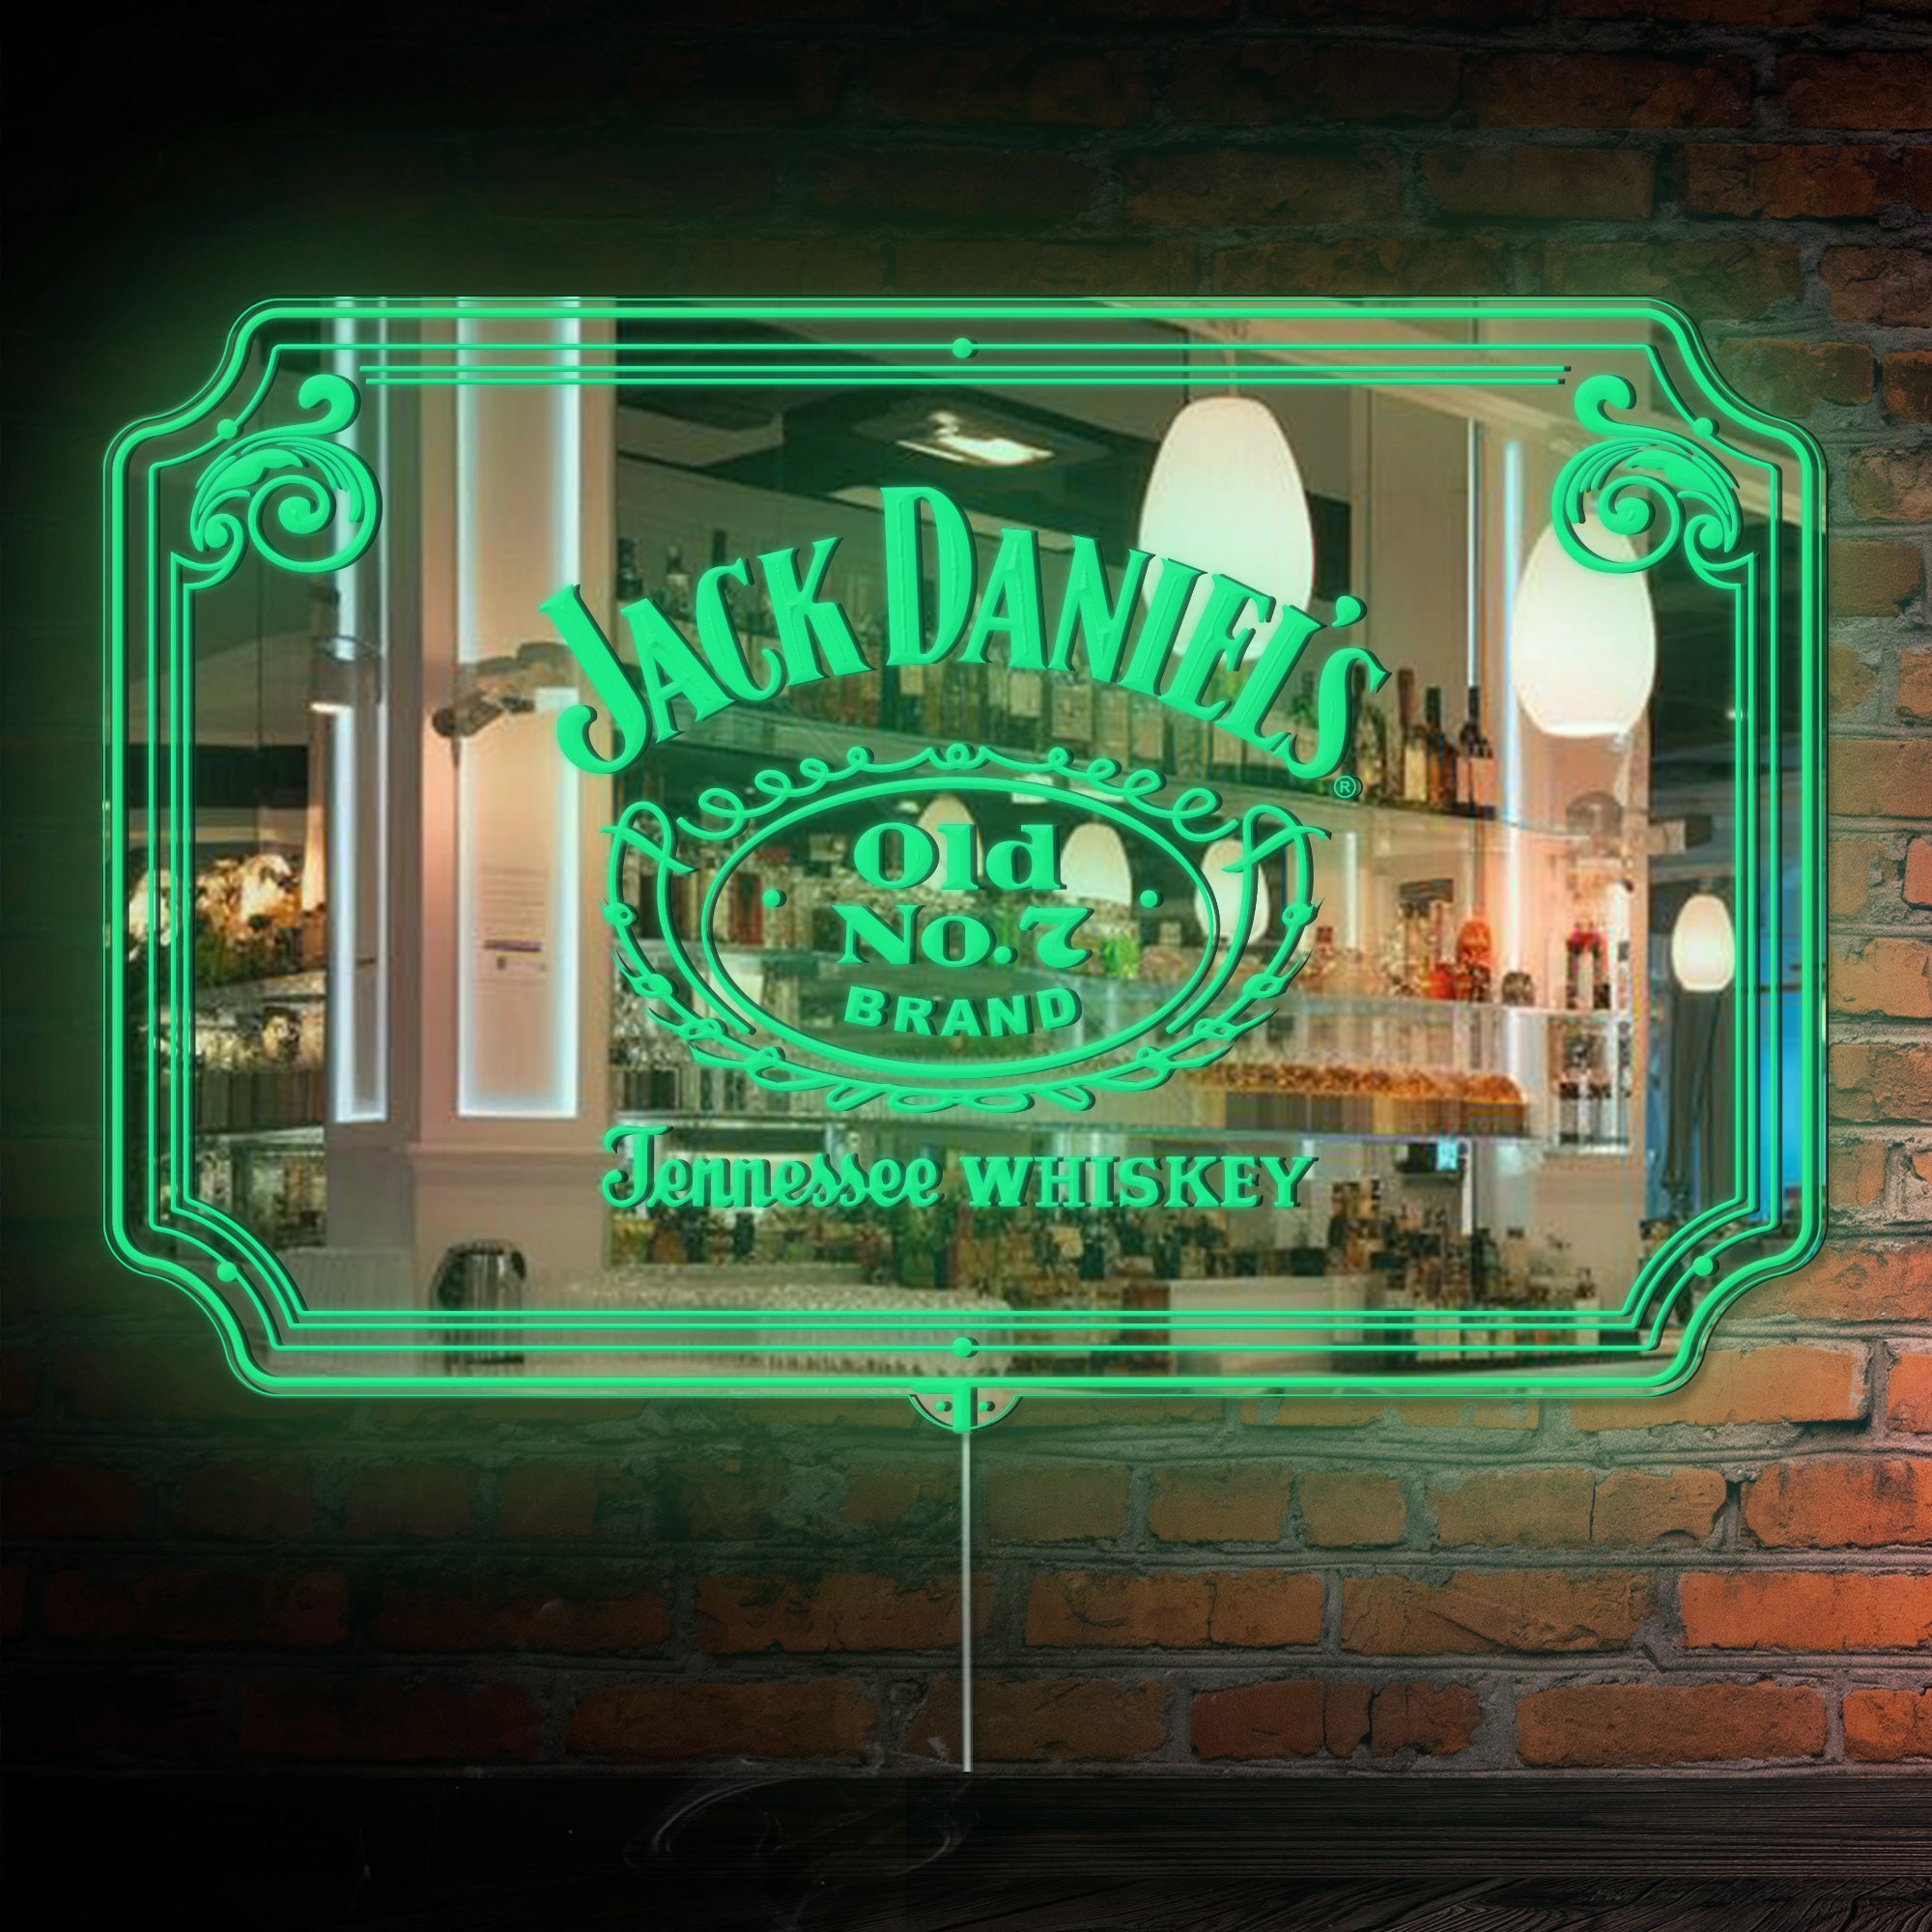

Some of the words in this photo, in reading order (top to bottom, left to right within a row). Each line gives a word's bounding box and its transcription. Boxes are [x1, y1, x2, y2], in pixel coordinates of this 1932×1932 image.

[538, 536, 877, 775] JACK
[880, 486, 1392, 780] DANIEL'S
[853, 821, 1065, 891] Old
[843, 984, 1082, 1037] BRAND
[601, 1125, 945, 1208] Tennessee
[959, 1155, 1319, 1208] WHISKEY
